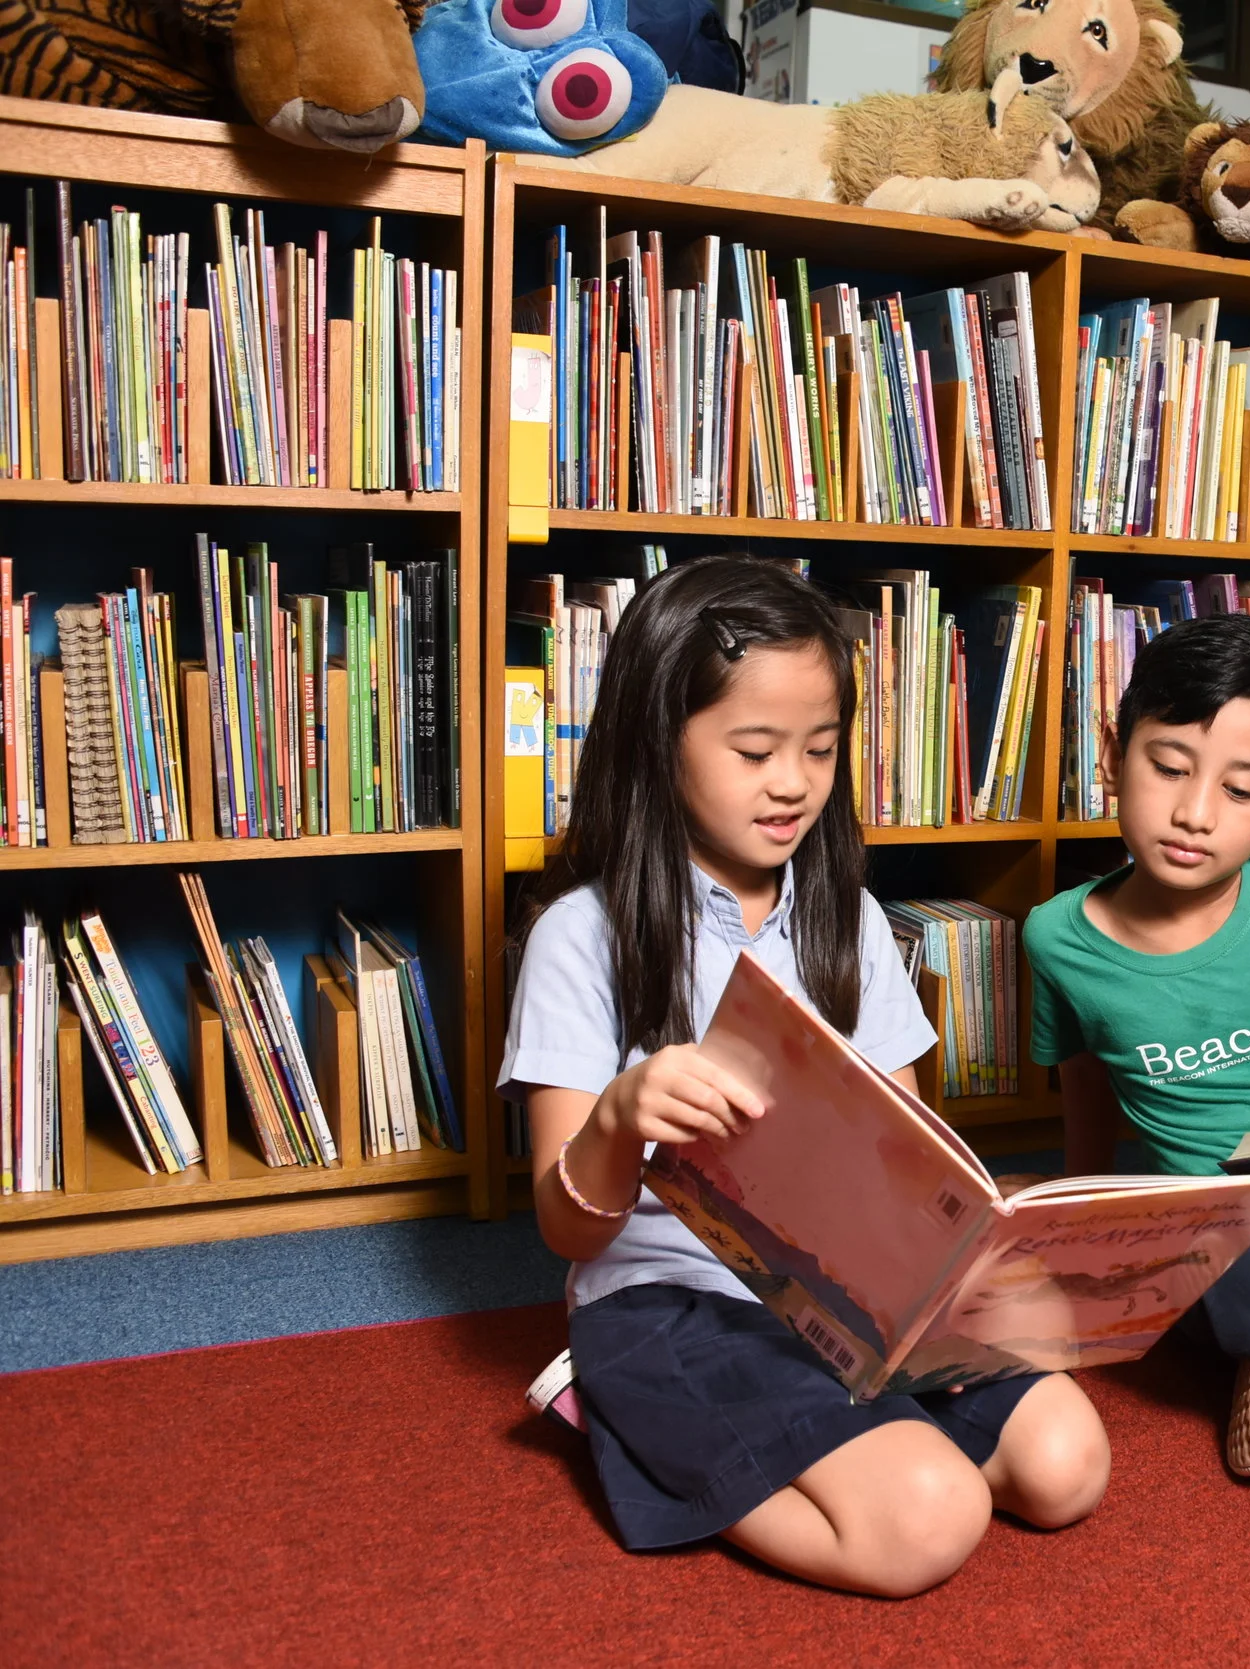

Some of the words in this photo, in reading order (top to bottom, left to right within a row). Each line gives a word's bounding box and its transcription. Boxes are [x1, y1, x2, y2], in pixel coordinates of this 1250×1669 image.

[231, 286, 237, 298] DO
[300, 294, 308, 346] ARTHUR'S
[432, 315, 440, 341] count
[432, 343, 440, 360] and
[806, 333, 815, 372] HENRY
[432, 362, 440, 378] see
[898, 361, 909, 385] LAST
[698, 379, 703, 387] MY
[301, 387, 309, 429] READER
[809, 378, 819, 419] WORKS
[902, 387, 913, 418] VIKING
[970, 394, 979, 420] Moved
[972, 421, 980, 433] My
[974, 435, 985, 468] Cheese?
[424, 656, 435, 671] The
[210, 673, 221, 711] Maria's
[304, 676, 314, 710] APPLES
[424, 673, 435, 695] Spider
[882, 681, 890, 704] Clatter
[424, 697, 434, 709] and
[546, 703, 555, 727] JUMP,
[213, 713, 223, 741] Comet
[306, 714, 315, 726] TO
[425, 711, 435, 723] the
[424, 725, 436, 737] Fly
[306, 730, 316, 765] OREGON
[79, 961, 96, 985] WENT
[89, 985, 109, 1019] SURFING
[105, 959, 126, 991] Touch
[117, 992, 132, 1013] and
[128, 1013, 143, 1037] Feel
[1149, 1078, 1166, 1086] THE
[1167, 1071, 1205, 1083] BEACON
[139, 1096, 158, 1129] Cabanting
[1094, 1224, 1178, 1247] Magic
